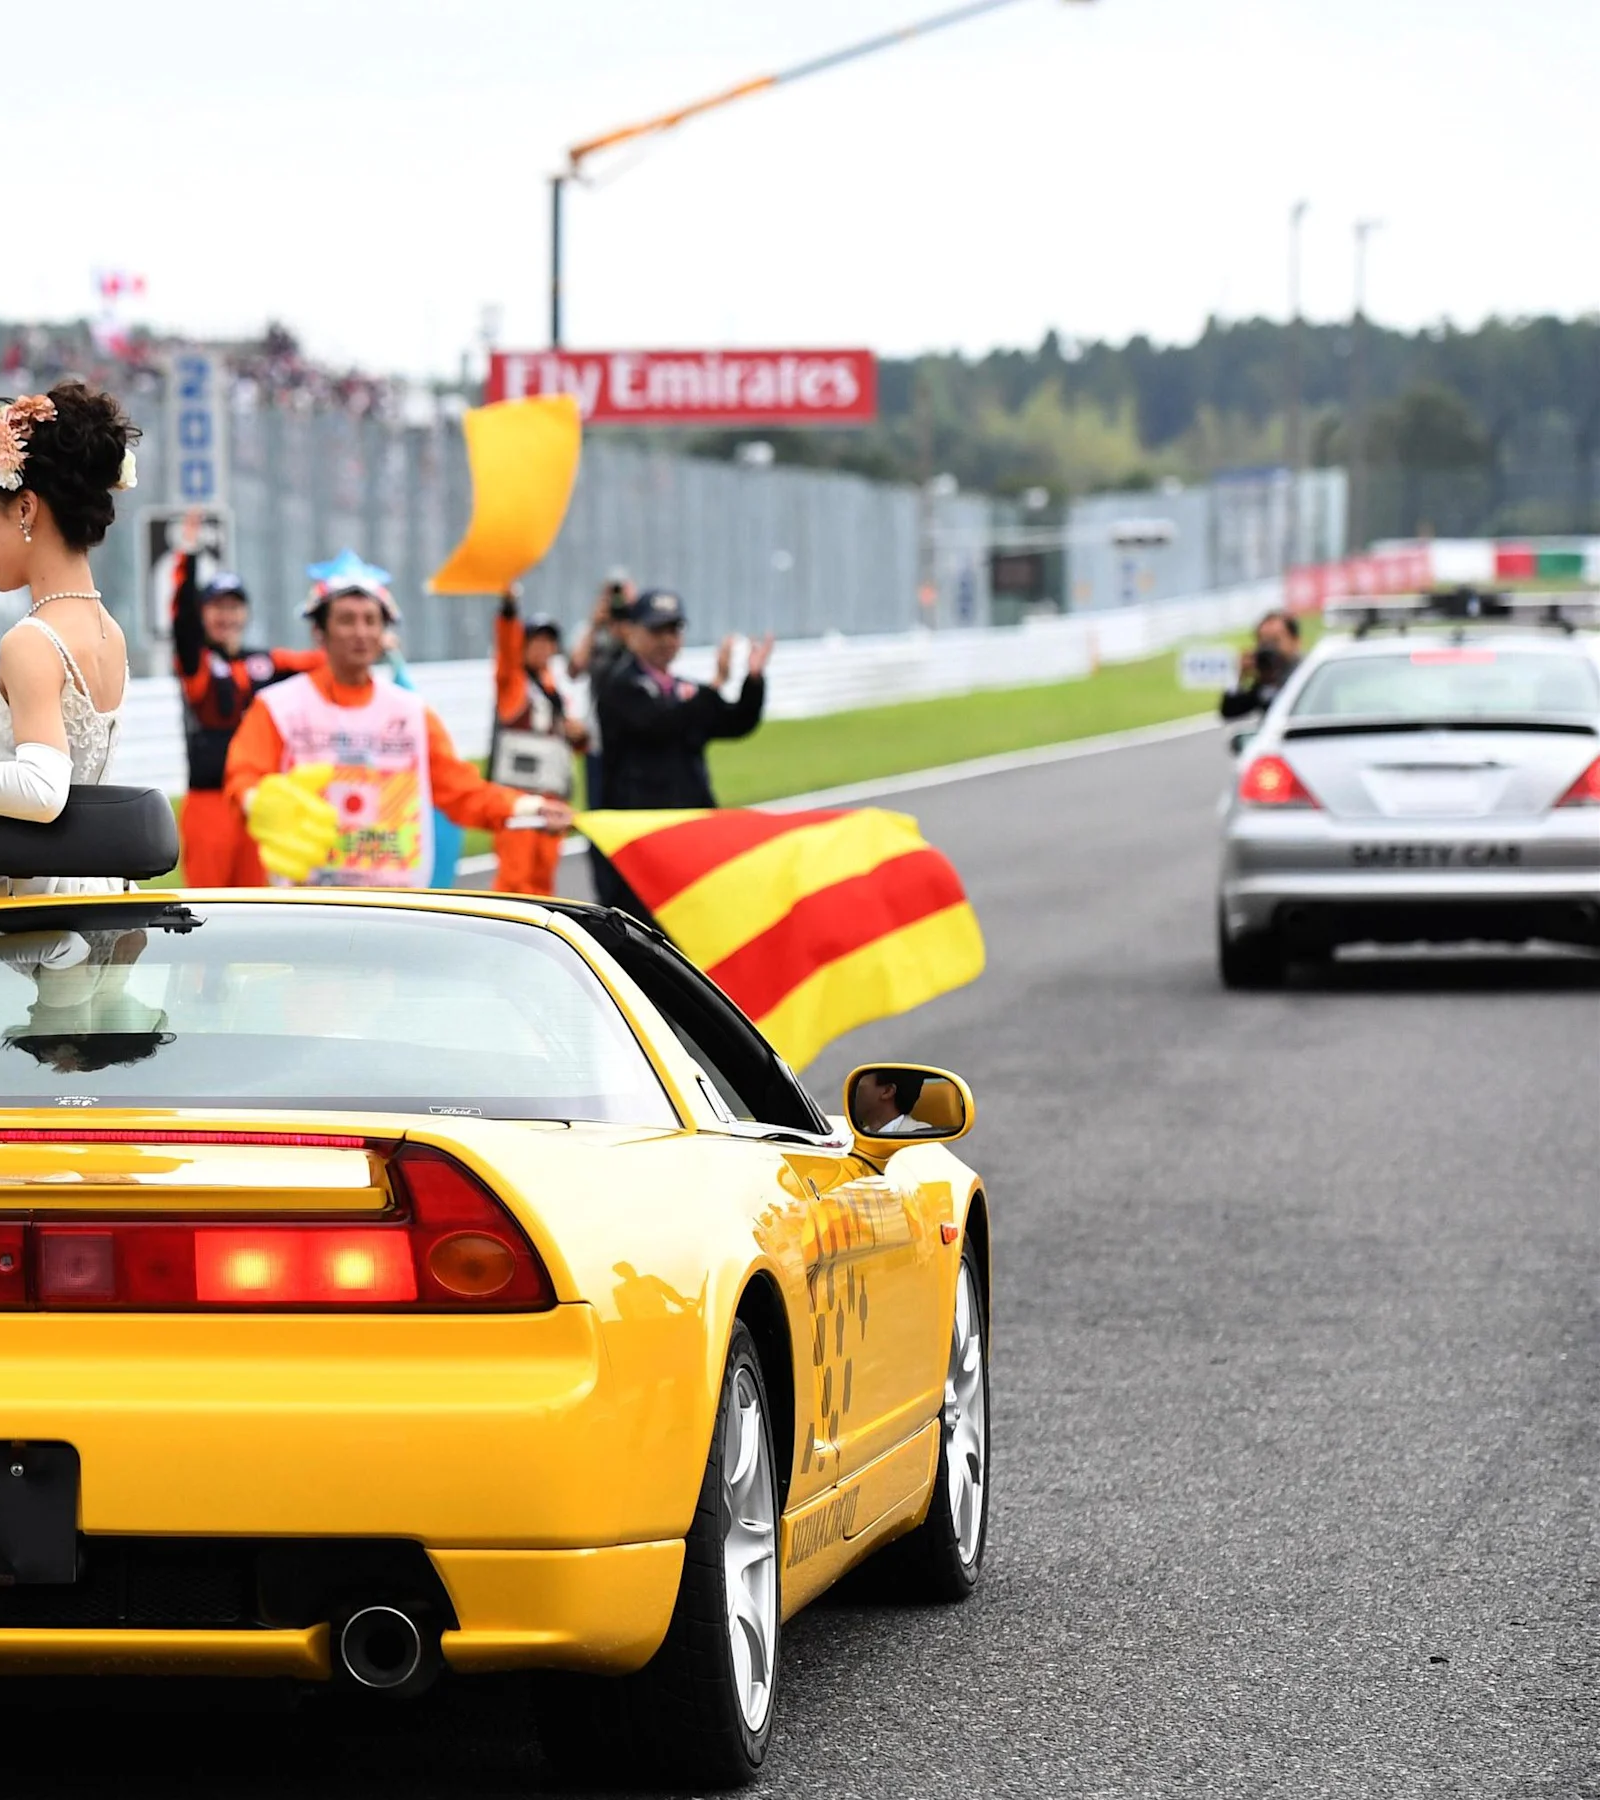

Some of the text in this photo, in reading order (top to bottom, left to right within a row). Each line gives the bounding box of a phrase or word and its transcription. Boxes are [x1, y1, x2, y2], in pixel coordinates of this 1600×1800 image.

[503, 352, 860, 420] Fly Emirates
[177, 357, 215, 498] 200
[1351, 842, 1522, 868] SAFETY CAR
